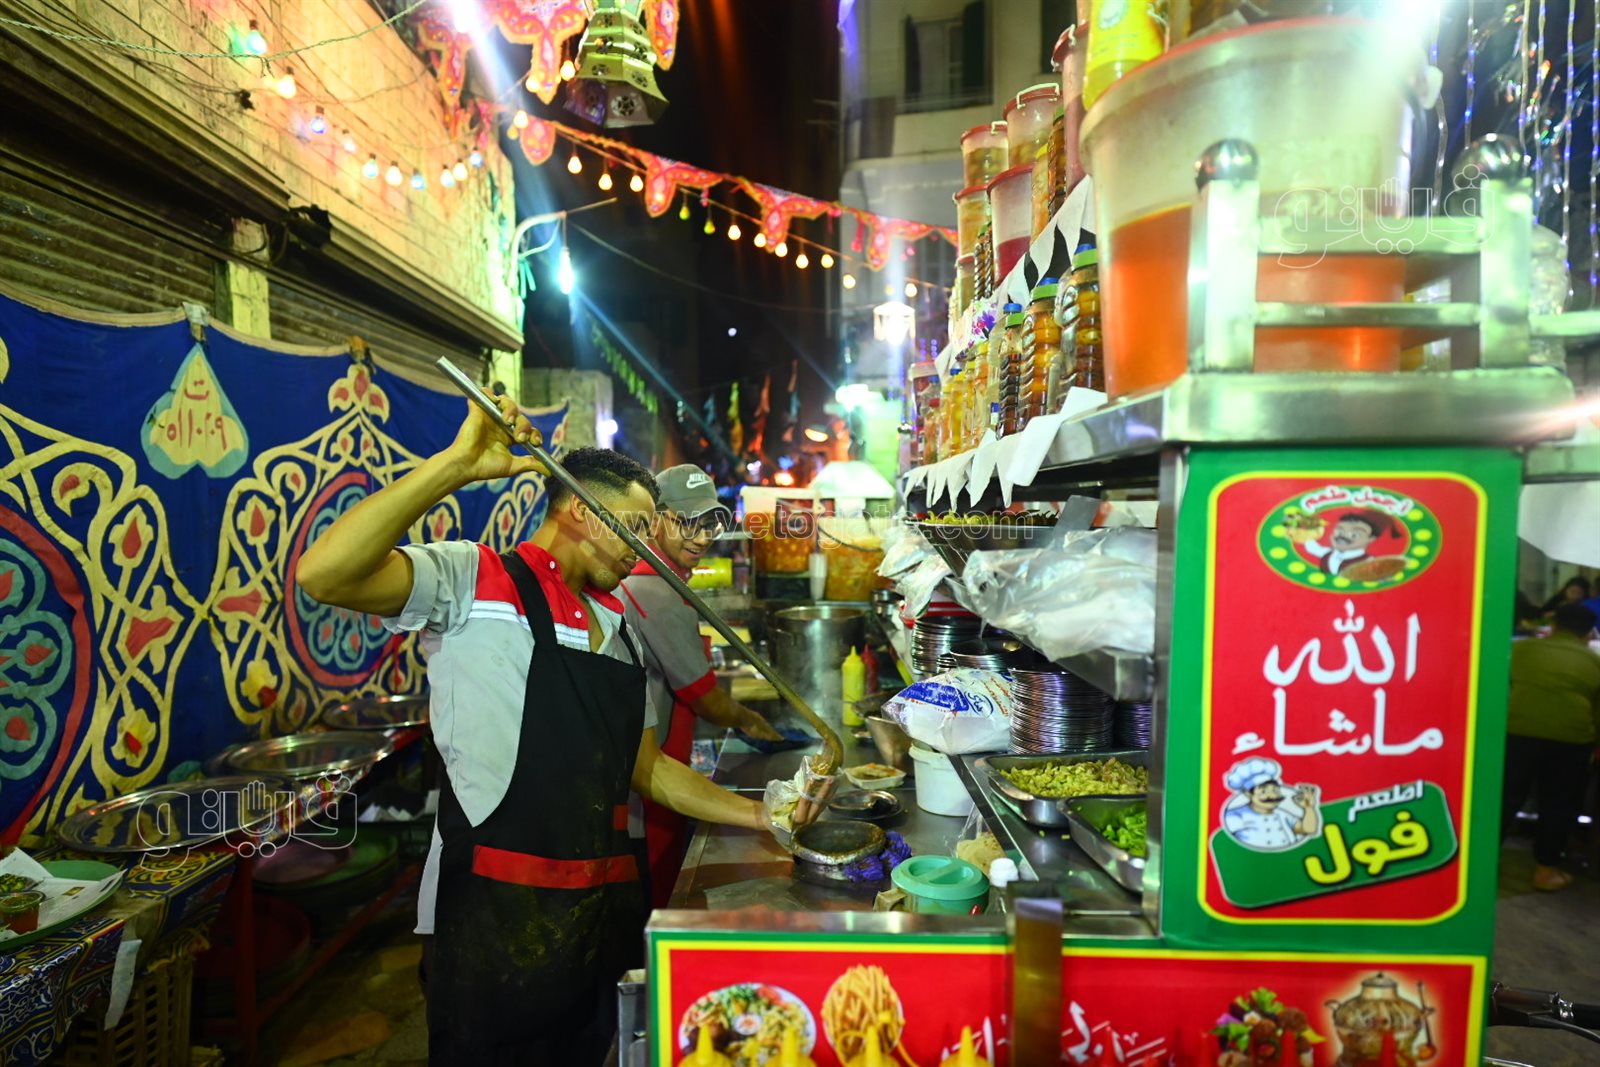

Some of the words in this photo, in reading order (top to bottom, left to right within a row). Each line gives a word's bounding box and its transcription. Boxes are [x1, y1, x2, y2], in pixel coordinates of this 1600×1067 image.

[1263, 599, 1421, 687] الله
[1232, 687, 1444, 756] ماشاء
[1303, 810, 1430, 885] فول
